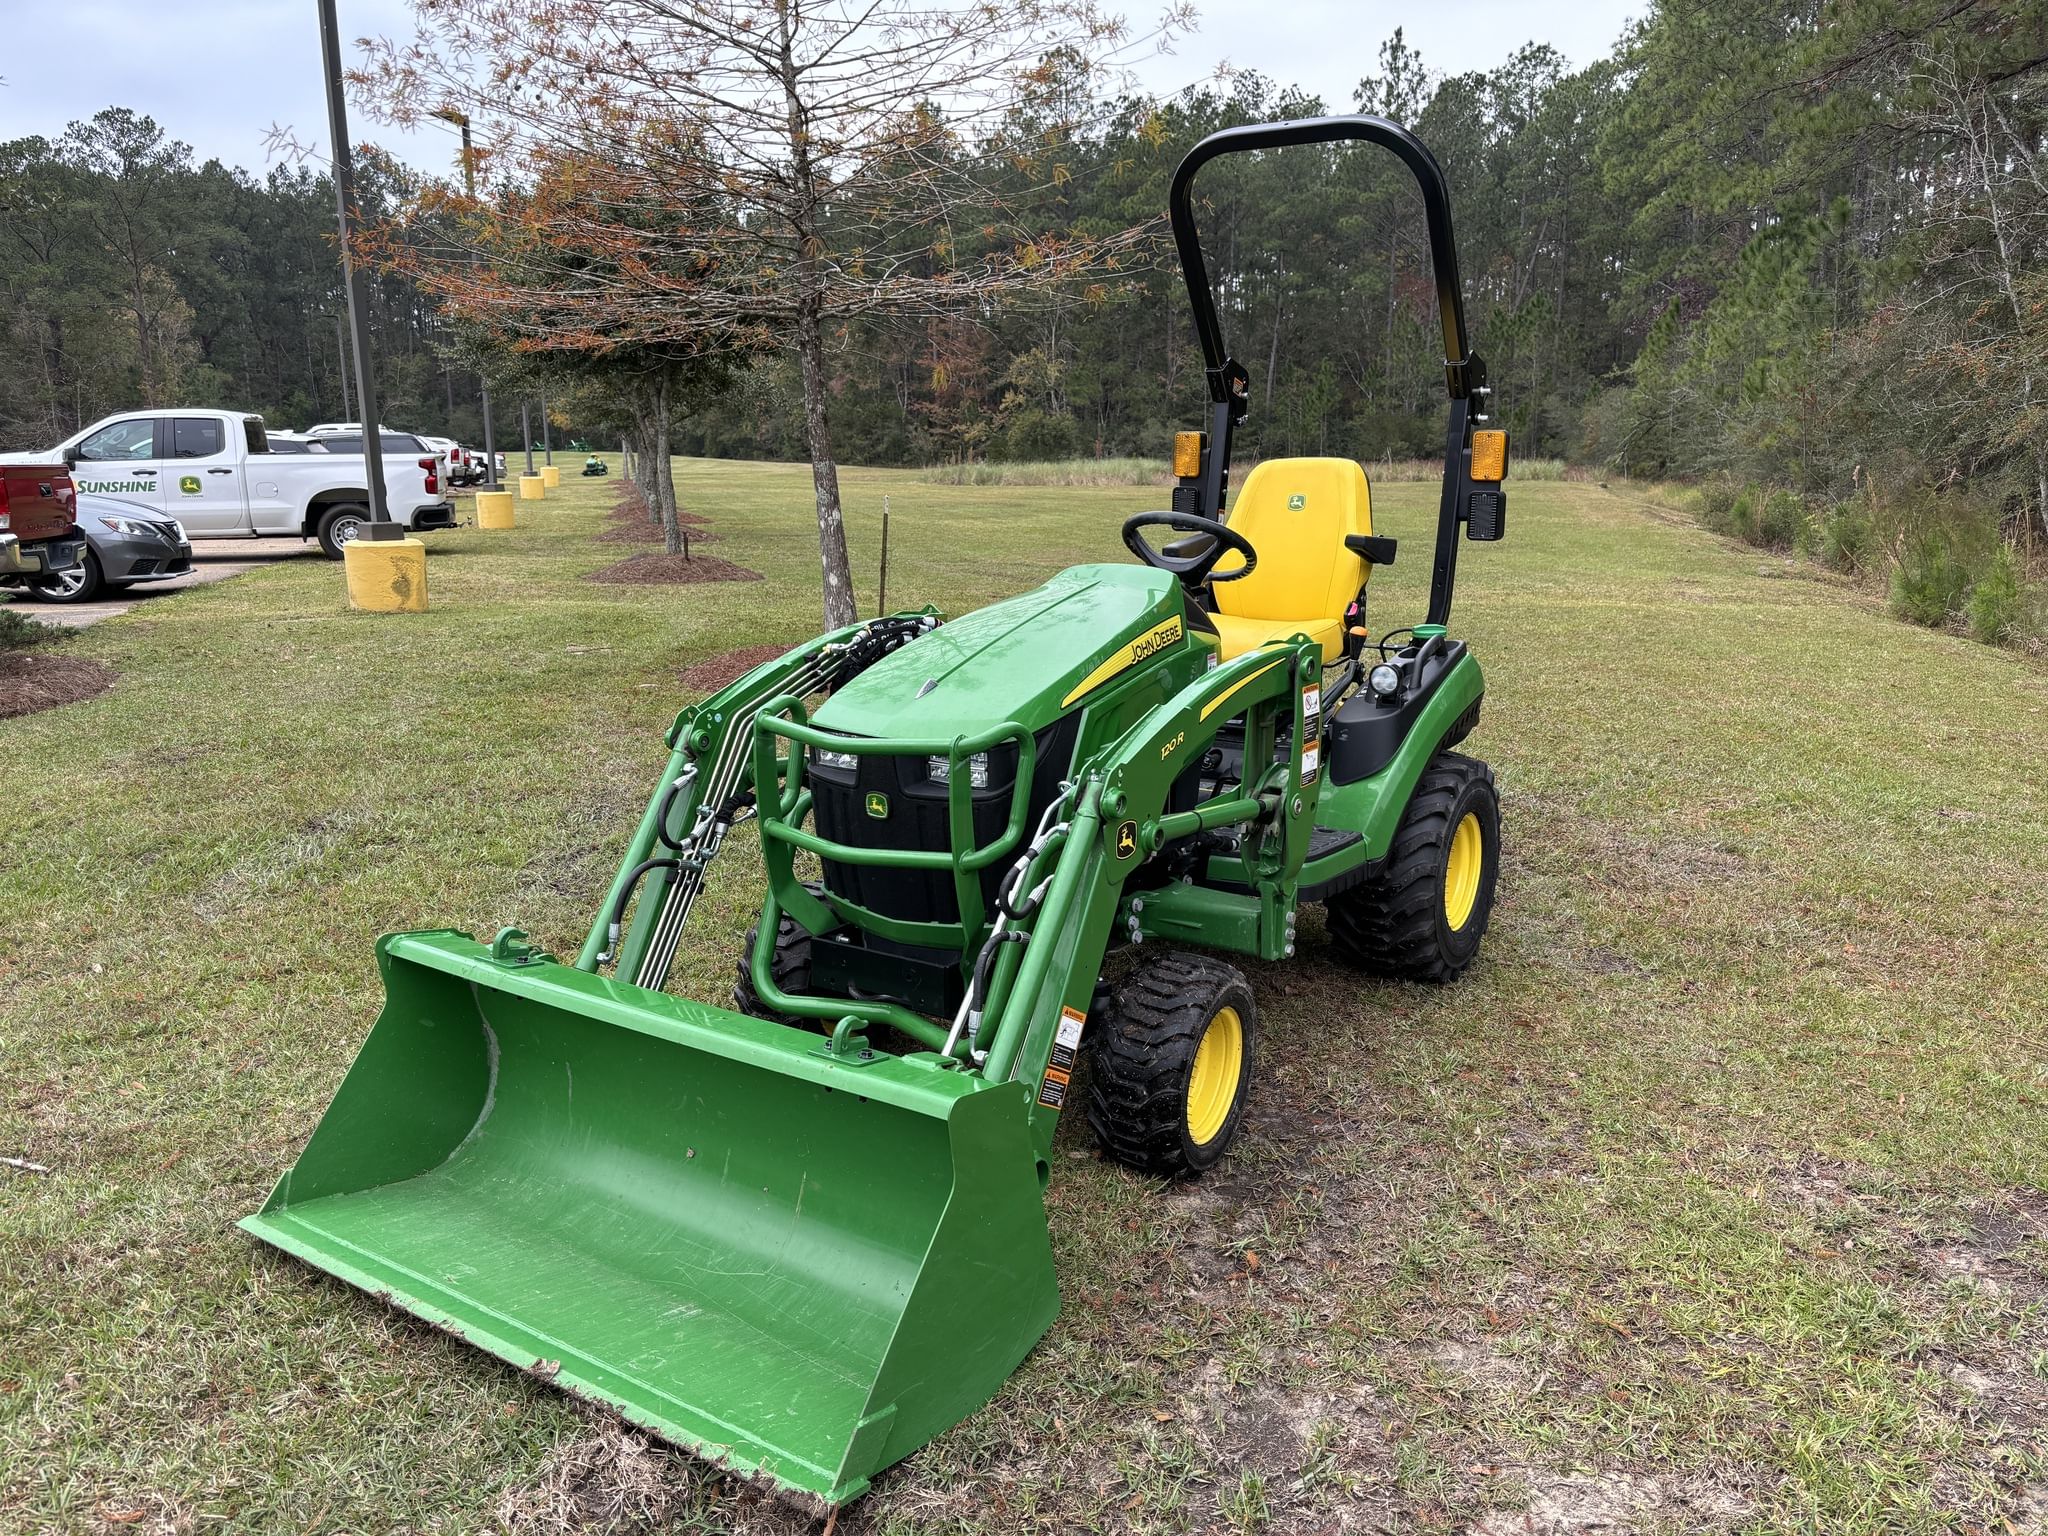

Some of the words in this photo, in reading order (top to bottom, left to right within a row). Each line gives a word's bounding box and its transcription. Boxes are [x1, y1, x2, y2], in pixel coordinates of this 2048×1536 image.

[77, 480, 157, 494] SUNSHINE
[1131, 637, 1155, 663] JOHN
[1153, 625, 1181, 647] DEERE
[1161, 738, 1177, 761] 120
[1176, 731, 1184, 746] R
